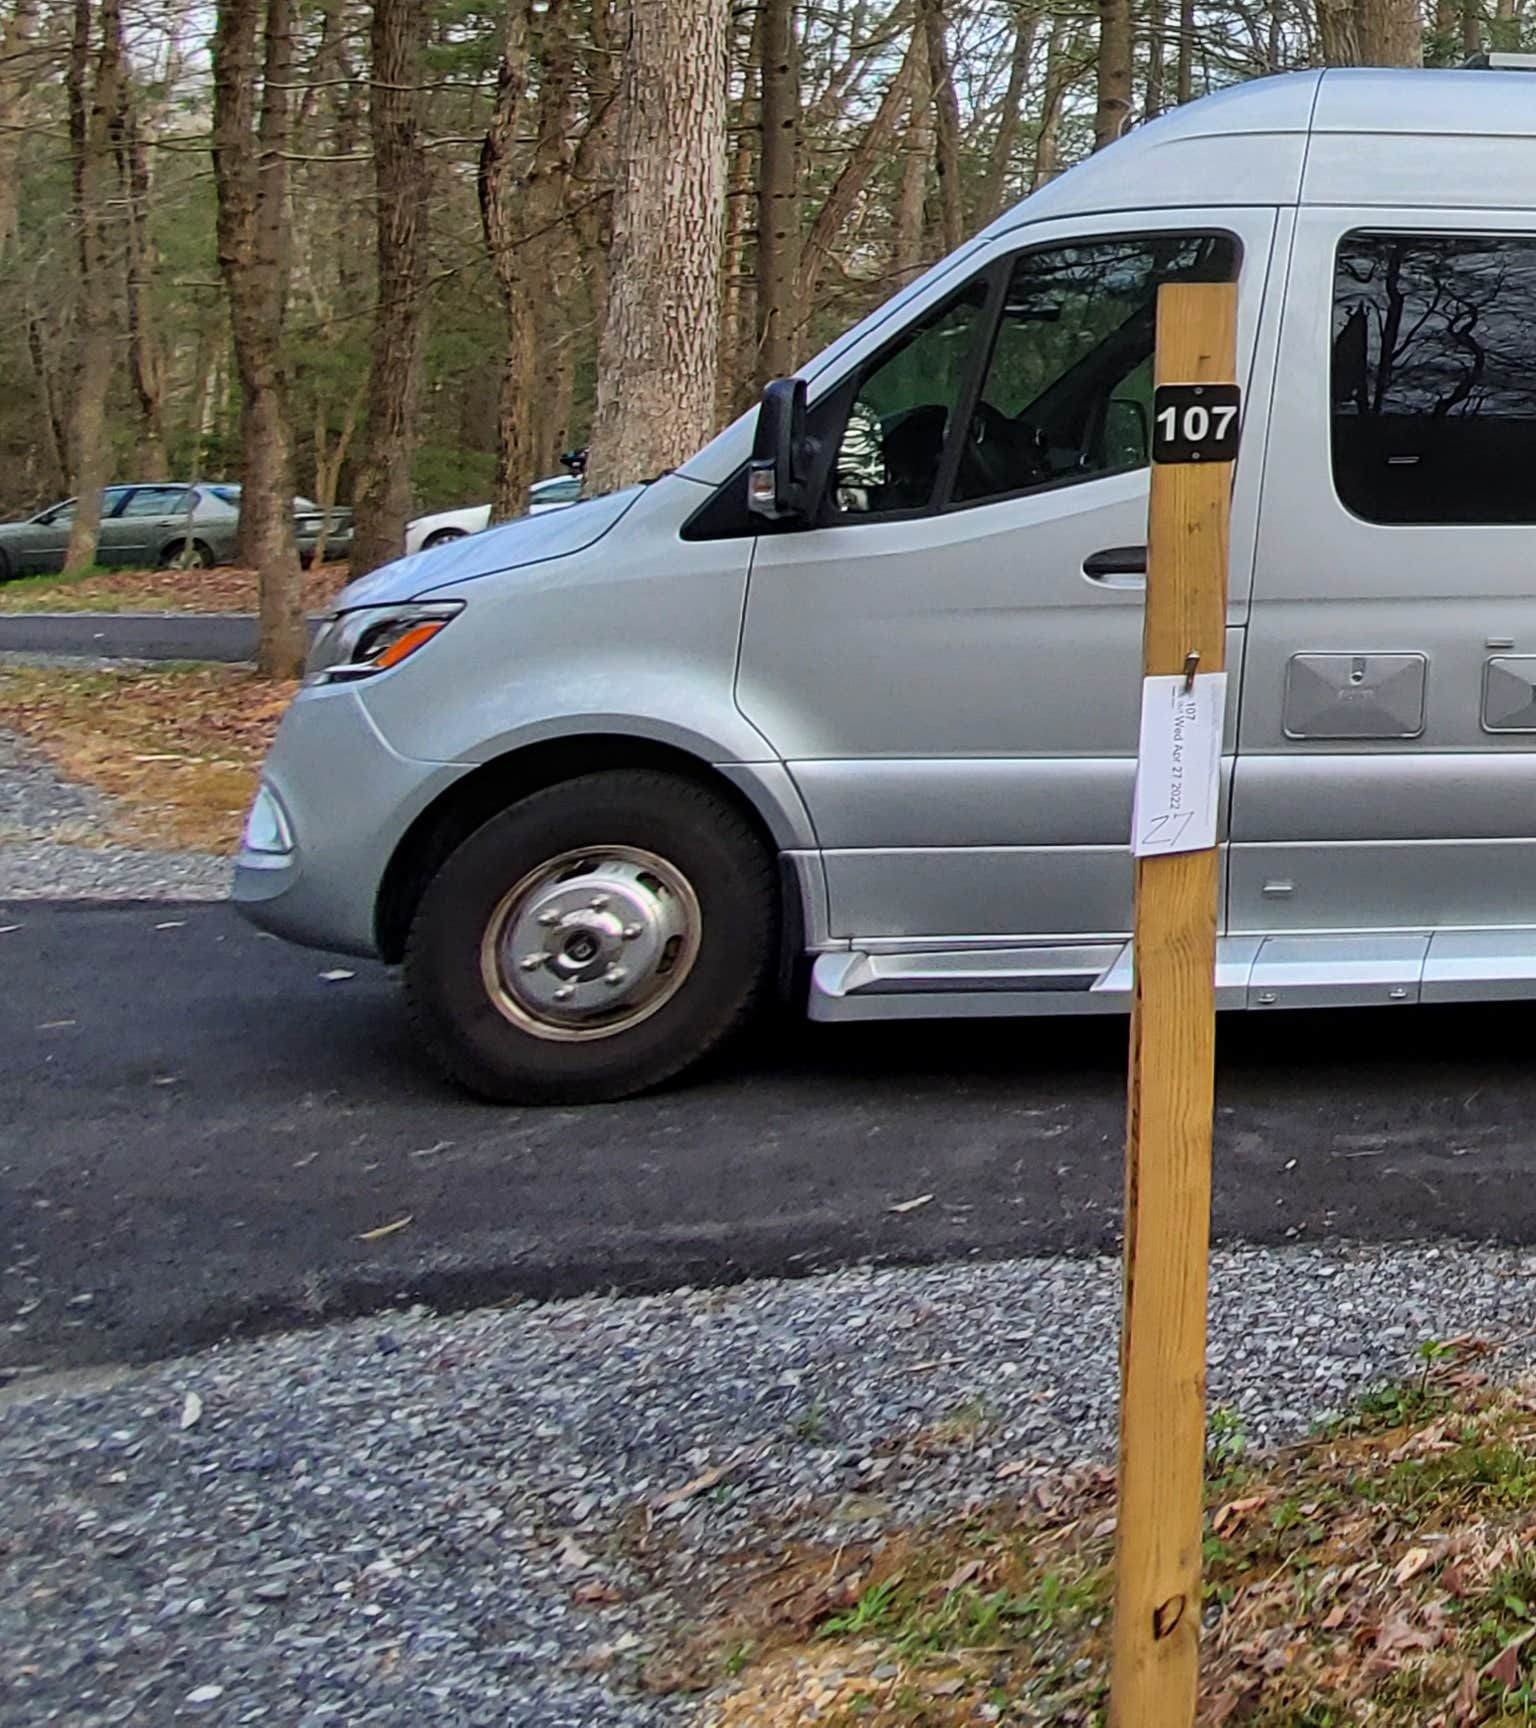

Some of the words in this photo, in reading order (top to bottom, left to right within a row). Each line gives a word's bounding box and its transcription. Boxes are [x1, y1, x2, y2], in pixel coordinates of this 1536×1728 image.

[1157, 406, 1238, 442] 107
[1185, 702, 1196, 721] 107
[1173, 715, 1185, 741] Wed
[1172, 744, 1184, 763] Apr
[1171, 766, 1182, 779] 27
[1169, 783, 1182, 811] 2022
